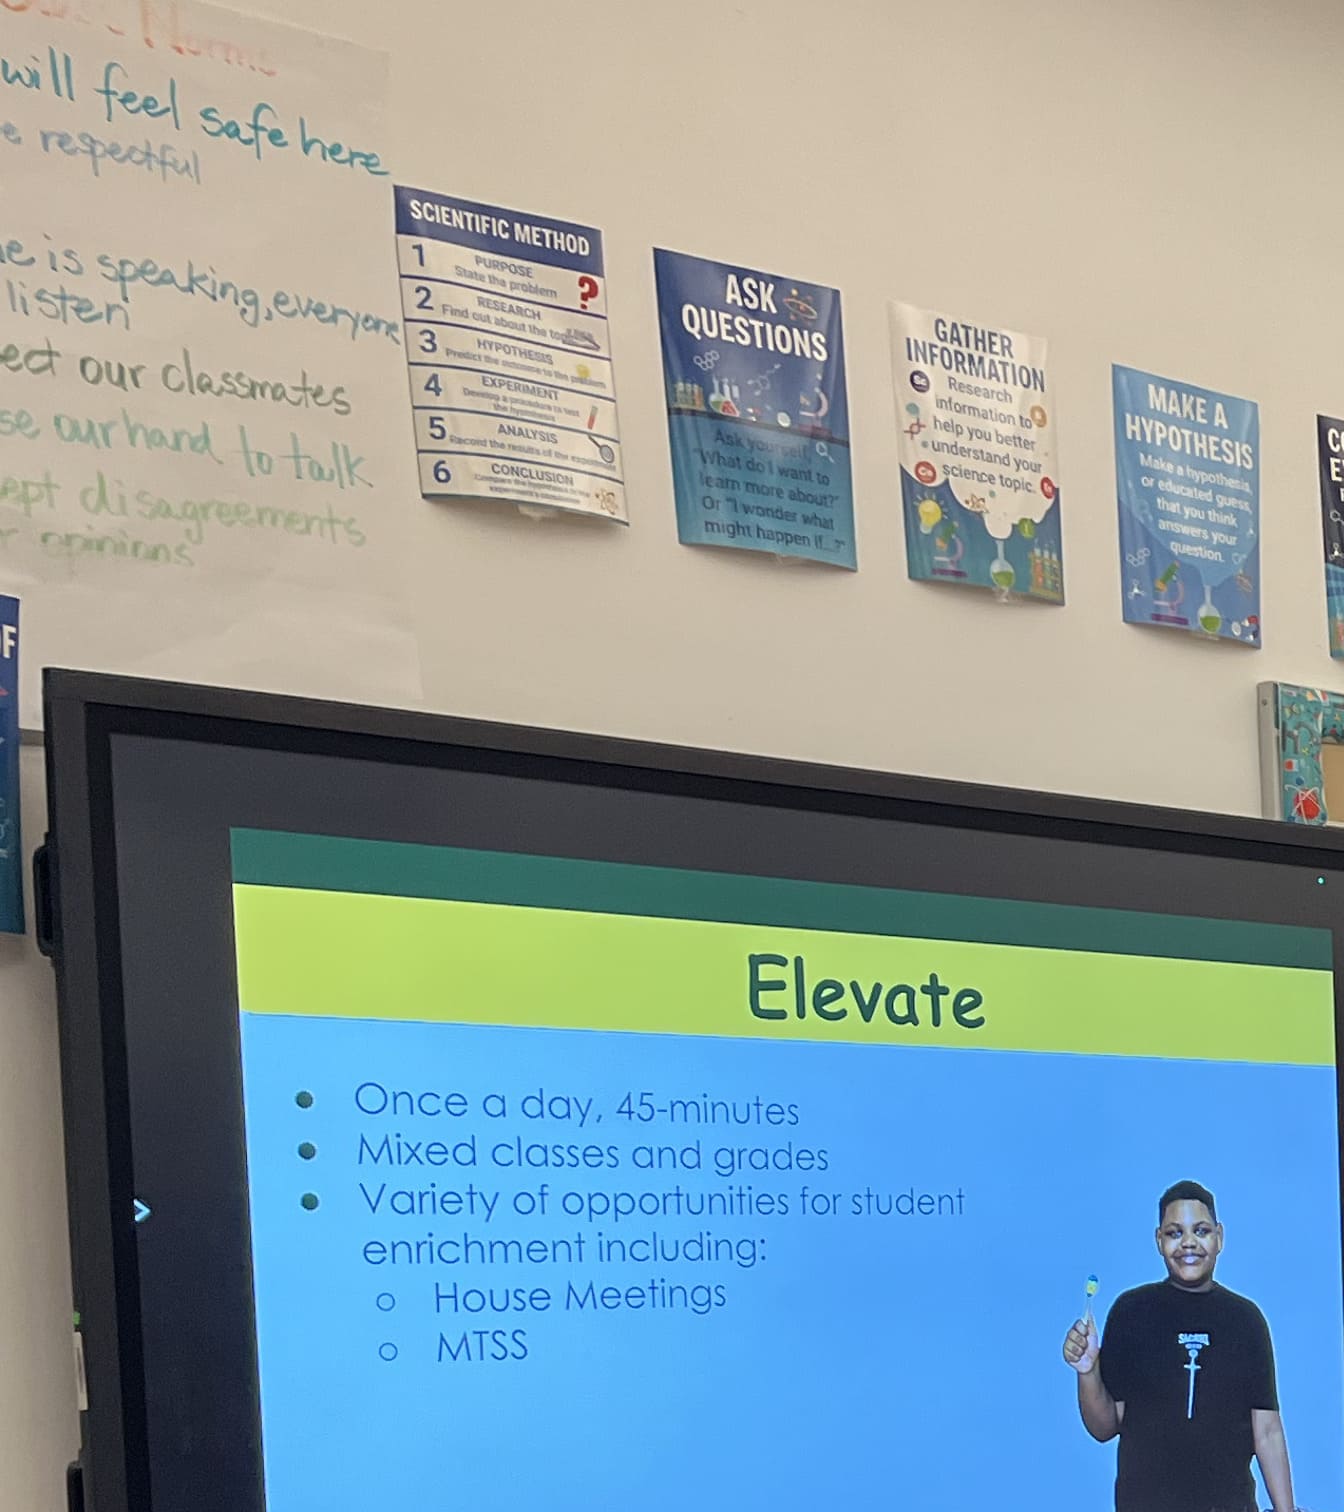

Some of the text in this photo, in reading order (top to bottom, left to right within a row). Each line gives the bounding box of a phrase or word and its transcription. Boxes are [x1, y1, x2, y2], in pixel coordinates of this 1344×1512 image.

[1, 46, 390, 176] will feel safe here
[39, 128, 201, 185] respectful
[409, 199, 590, 256] SCIENTIFIC METHOD
[44, 232, 85, 276] is
[411, 243, 425, 267] 1
[475, 255, 534, 278] PURPOSE
[6, 280, 131, 331] listen
[414, 286, 434, 311] 2
[476, 295, 542, 320] RESEARCH
[725, 273, 778, 314] ASK
[418, 329, 438, 353] 3
[681, 303, 829, 362] QUESTIONS
[934, 318, 1014, 359] GATHER
[476, 338, 554, 366] HYPOTHESIS
[906, 337, 1046, 393] INFORMATION
[79, 354, 147, 392] our
[161, 347, 352, 416] classmates
[423, 373, 443, 397] 4
[481, 375, 560, 401] EXPERIMENT
[947, 376, 1013, 404] Research
[935, 397, 1033, 430] information to
[1147, 383, 1229, 429] MAKE A
[428, 416, 446, 440] 5
[497, 424, 558, 444] ANALYSIS
[933, 415, 1036, 452] help you better
[1125, 413, 1254, 470] HYPOTHESIS
[54, 411, 119, 450] our
[121, 408, 224, 464] hand
[232, 424, 274, 477] to
[279, 431, 374, 489] talk
[931, 440, 1042, 475] understand your
[433, 460, 451, 484] 6
[491, 463, 575, 487] CONCLUSION
[942, 463, 1037, 495] science topic.
[79, 471, 367, 547] disagreements
[748, 952, 988, 1030] Elevate
[354, 1082, 801, 1128] Once a day, 45-minutes
[357, 1132, 830, 1176] Mixed classes and grades
[359, 1182, 966, 1222] Variety of opportunities for student
[362, 1231, 767, 1268] enrichment including:
[435, 1278, 728, 1315] House Meetings
[437, 1329, 529, 1364] MTSS
